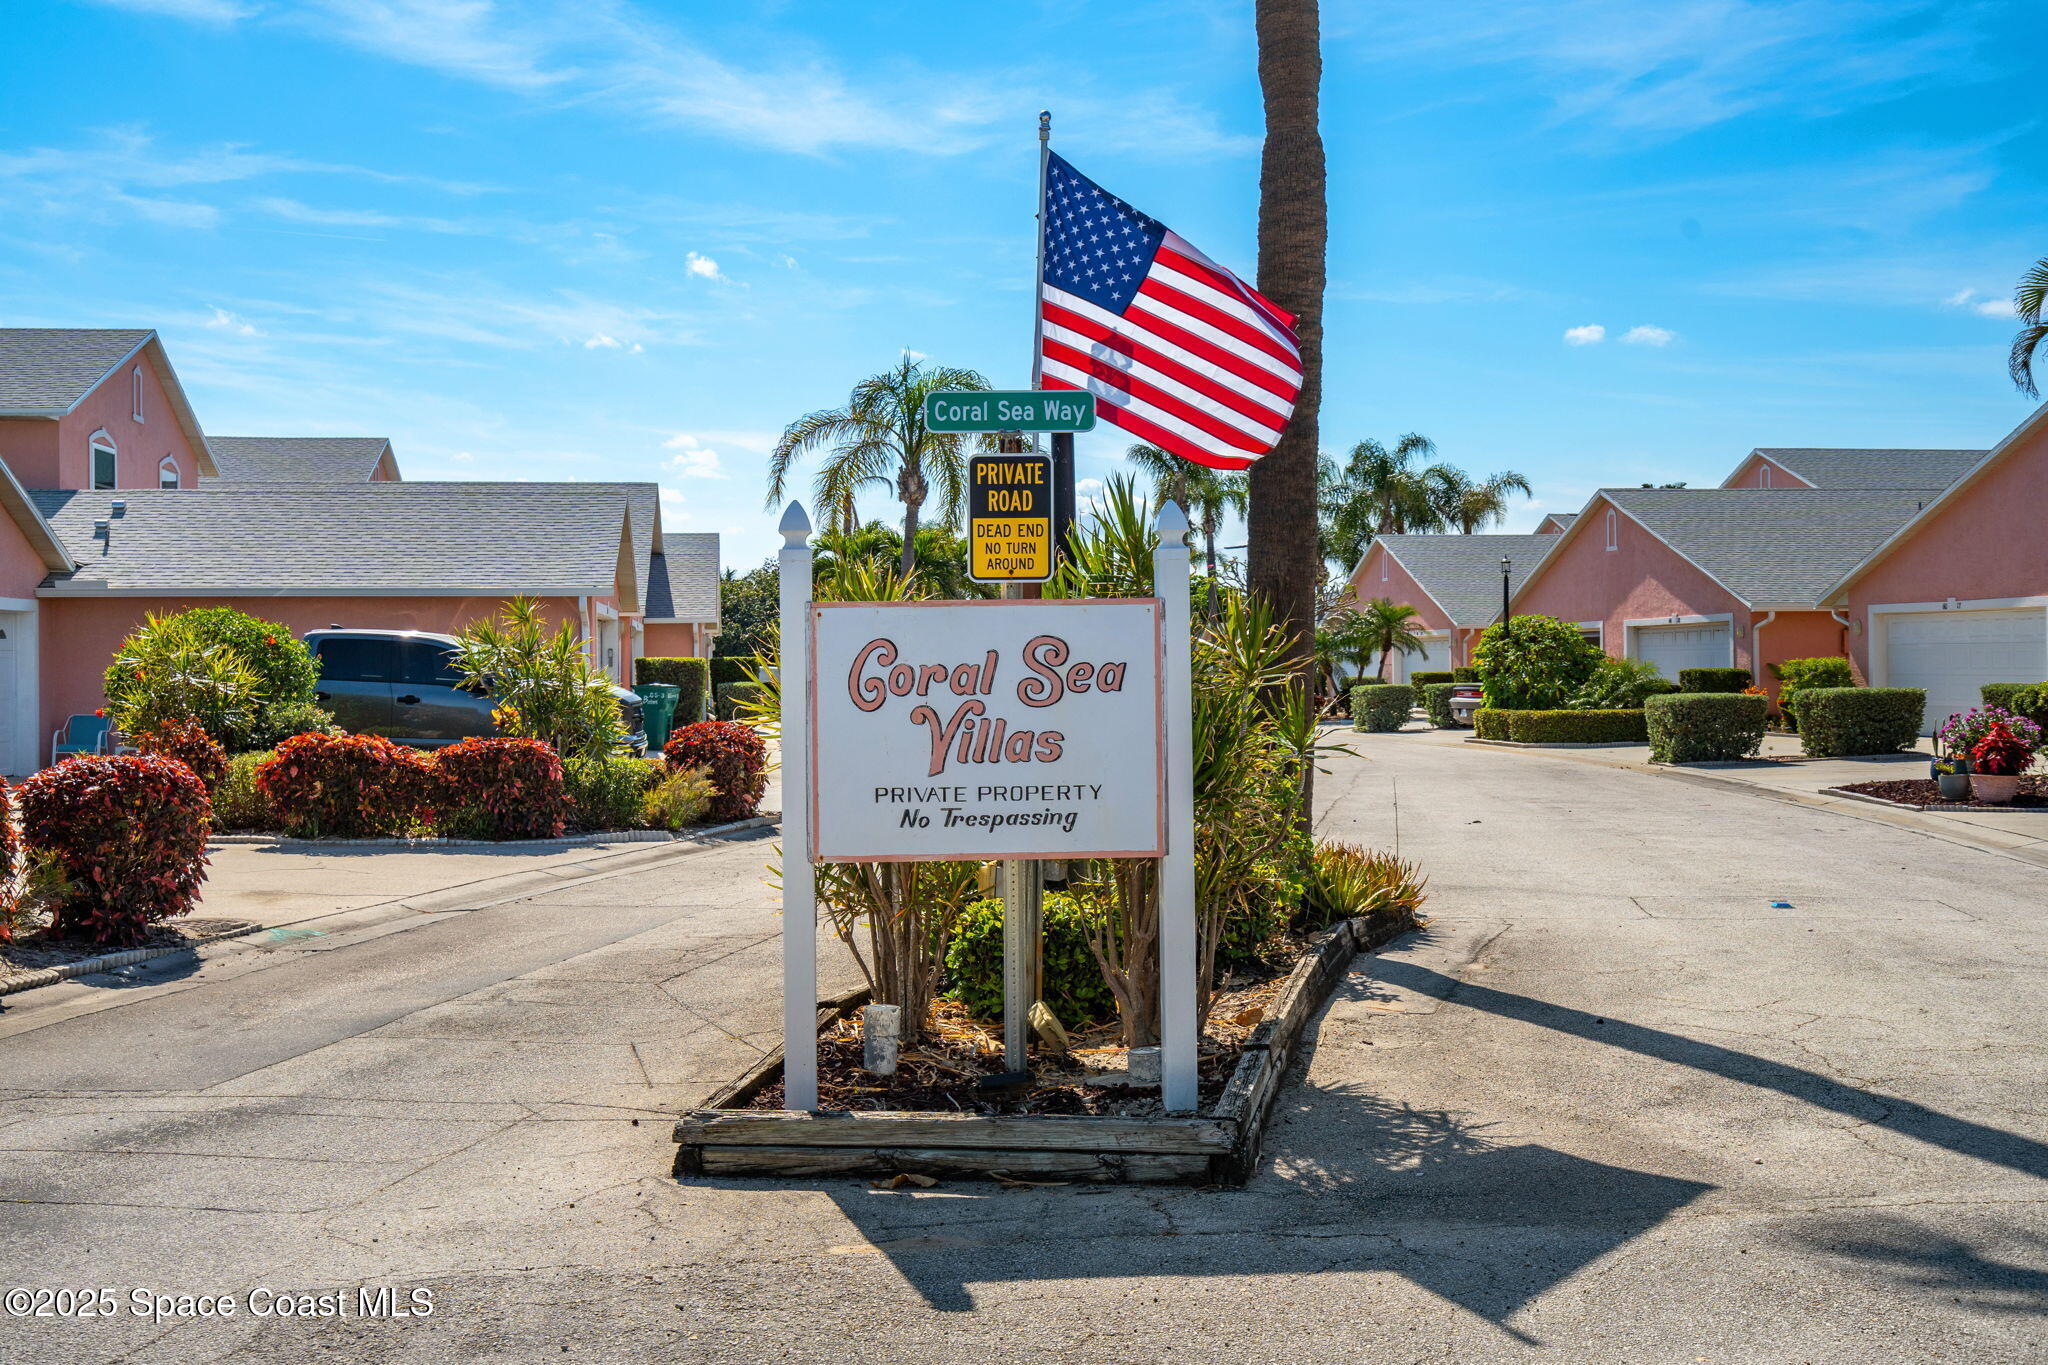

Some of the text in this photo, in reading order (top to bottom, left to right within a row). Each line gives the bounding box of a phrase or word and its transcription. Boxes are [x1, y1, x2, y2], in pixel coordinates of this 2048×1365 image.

[934, 400, 1086, 426] Coral Sea Way
[977, 463, 1044, 485] PRIVATE
[988, 490, 1033, 512] ROAD
[977, 523, 1044, 538] DEAD END
[985, 542, 1036, 555] NO TURN
[986, 557, 1035, 570] AROUND
[848, 635, 1127, 712] Coral Sea
[910, 699, 1065, 777] Villas
[874, 784, 1103, 803] PRIVATE PROPERTY
[900, 807, 1078, 833] No Trespassing
